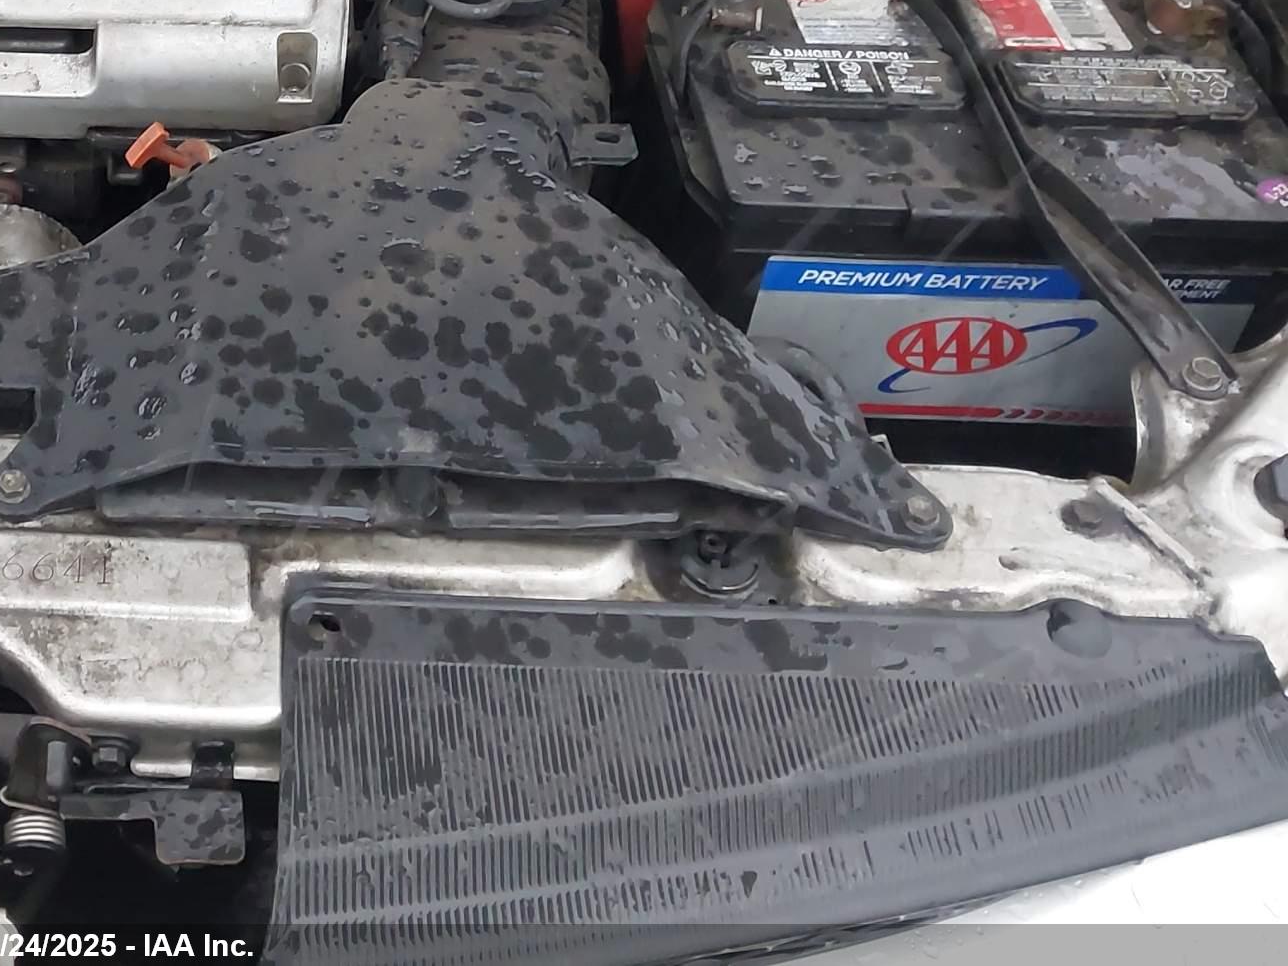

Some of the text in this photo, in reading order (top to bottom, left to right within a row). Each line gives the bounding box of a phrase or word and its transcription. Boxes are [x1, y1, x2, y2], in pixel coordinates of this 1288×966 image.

[782, 48, 910, 61] DANGER / POISON
[798, 269, 1050, 292] PREMIUM BATTERY
[1162, 278, 1231, 290] AR FREE
[895, 318, 1020, 372] AAA
